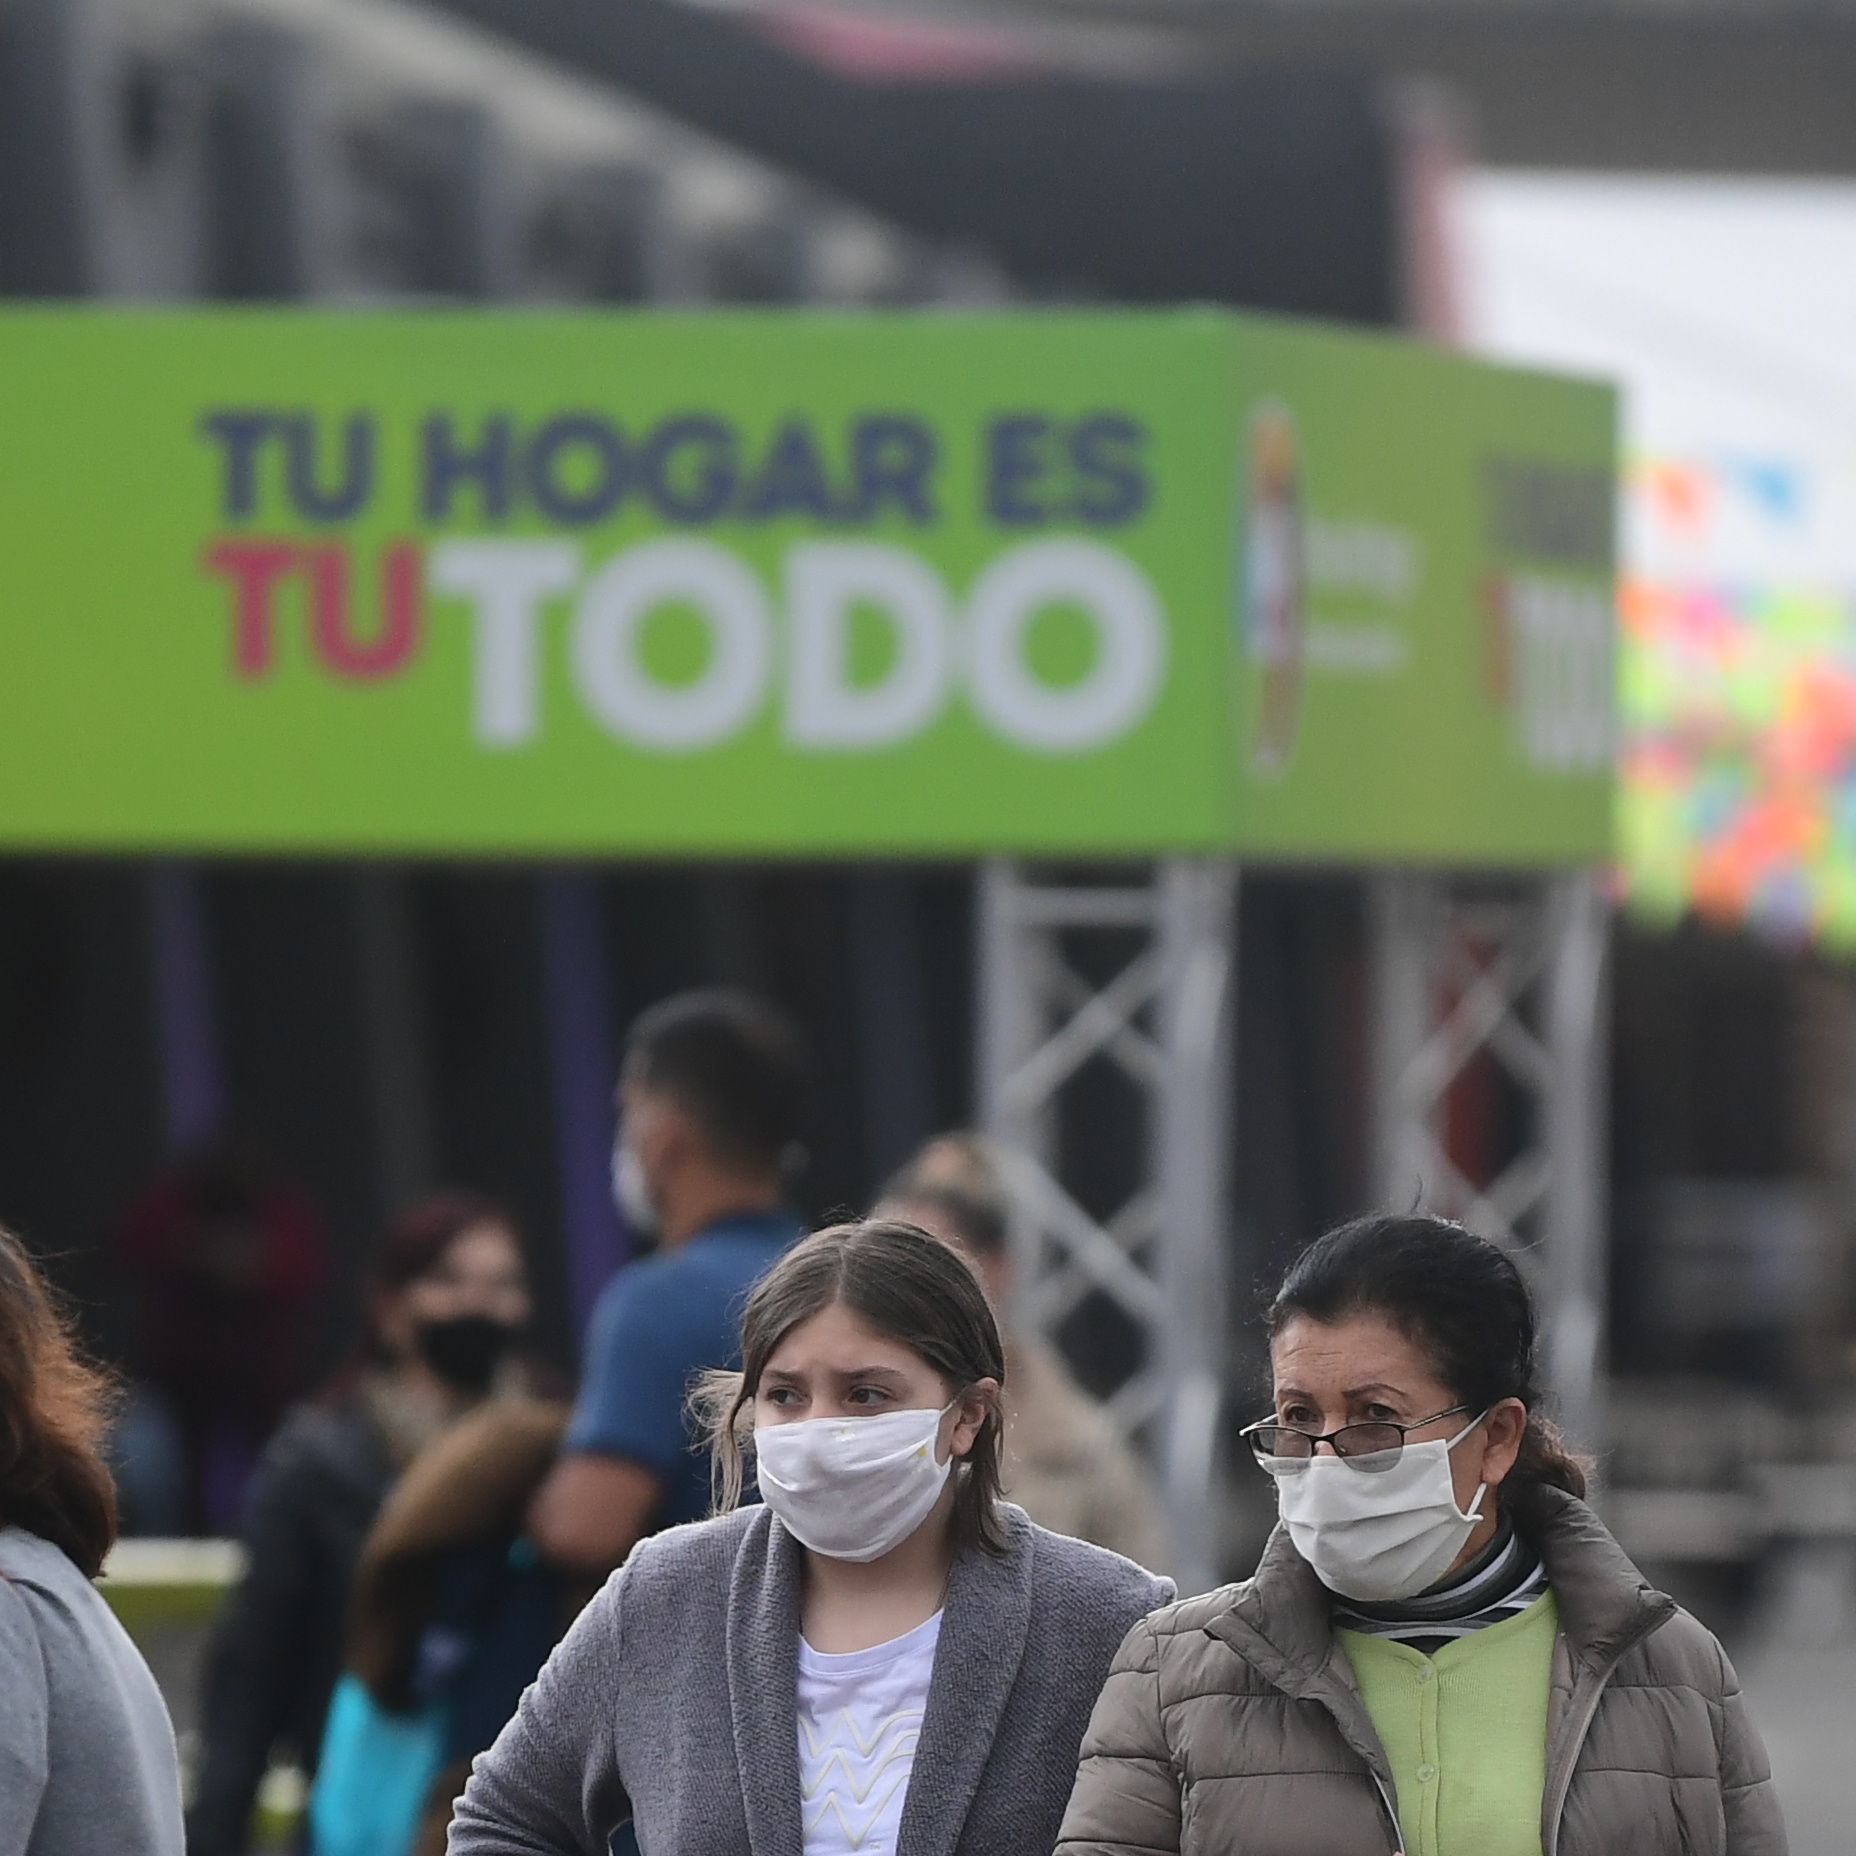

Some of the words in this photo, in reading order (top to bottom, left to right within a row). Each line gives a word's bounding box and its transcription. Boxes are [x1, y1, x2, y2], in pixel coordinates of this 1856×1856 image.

[202, 410, 376, 524] TU
[421, 410, 936, 528] HOGAR
[984, 410, 1154, 530] ES
[204, 537, 426, 684] TU
[429, 535, 1168, 755] TODO
